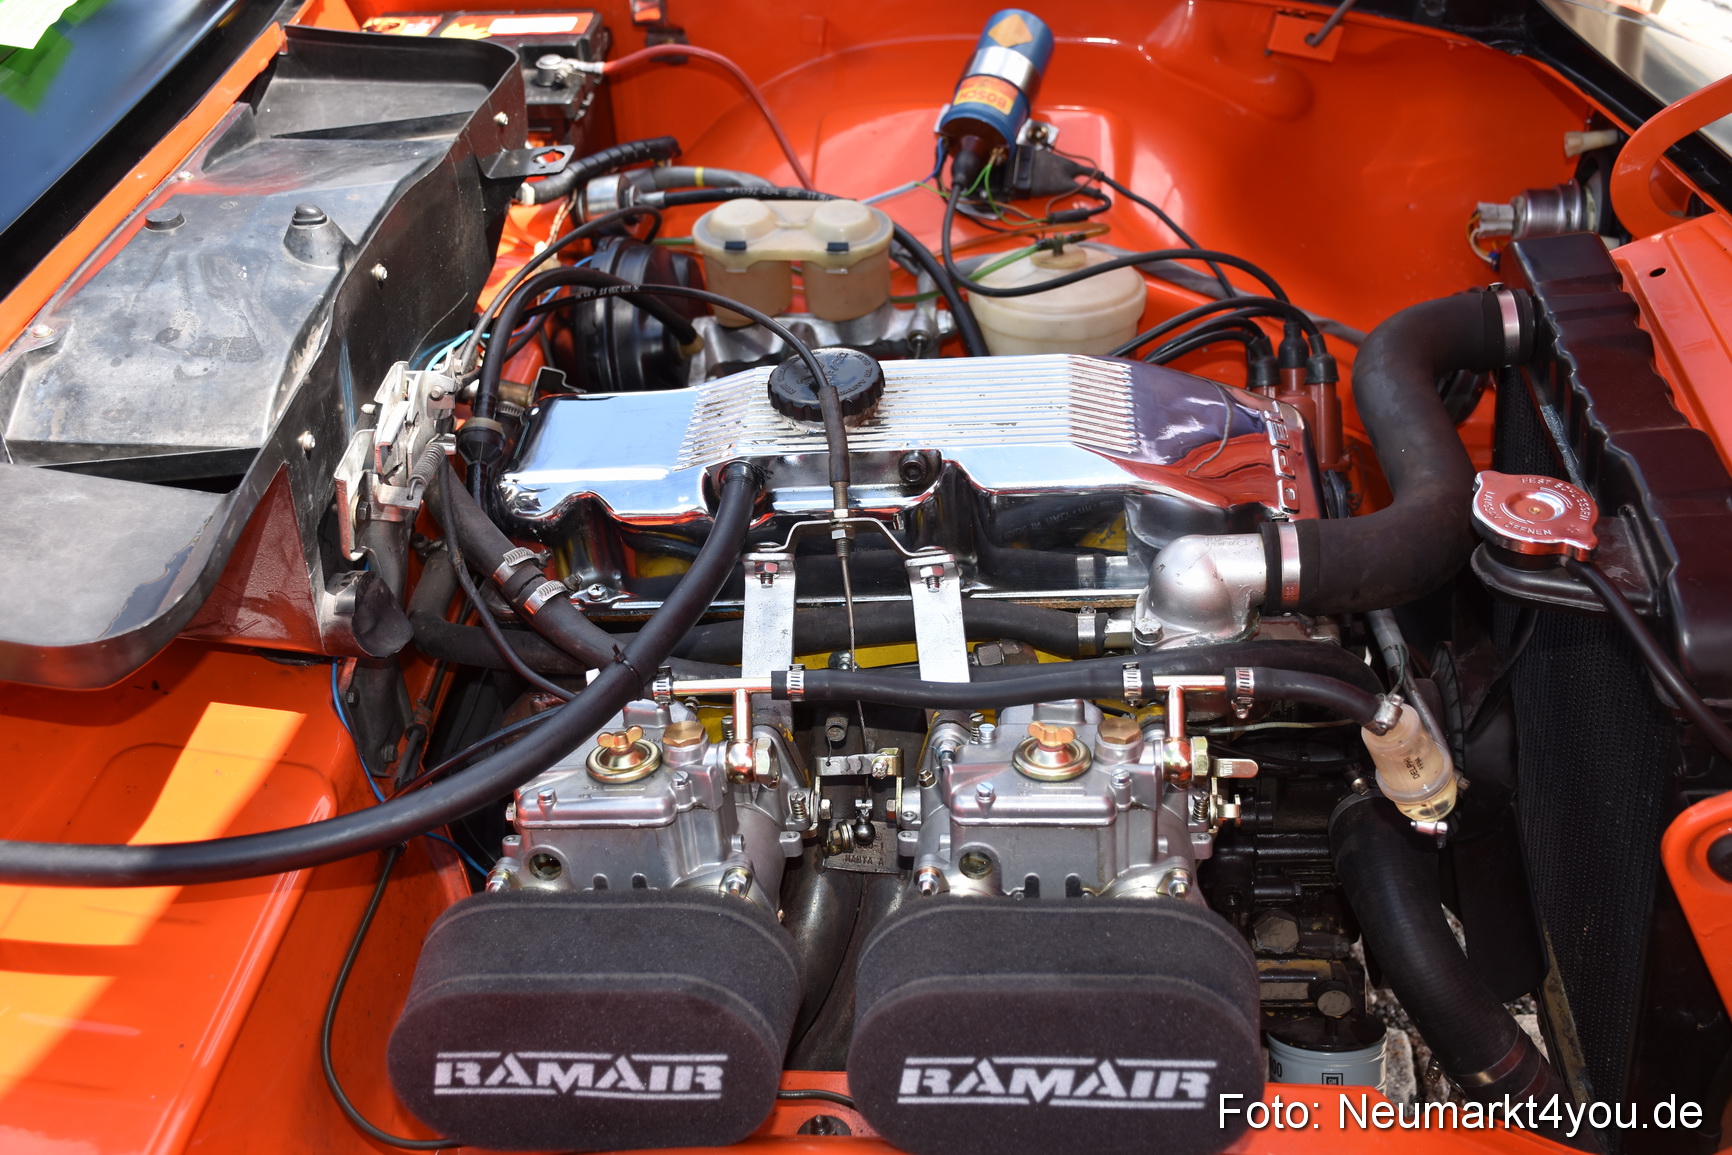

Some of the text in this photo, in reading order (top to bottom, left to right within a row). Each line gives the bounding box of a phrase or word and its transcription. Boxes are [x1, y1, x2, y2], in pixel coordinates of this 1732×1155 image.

[959, 90, 1008, 108] BOSCH
[1264, 400, 1300, 515] OPEL
[1521, 477, 1552, 485] FEST
[1403, 756, 1420, 779] DELPHI
[844, 854, 873, 865] MANTA
[433, 1051, 729, 1101] RAMAIR
[896, 1056, 1218, 1109] RAMAIR
